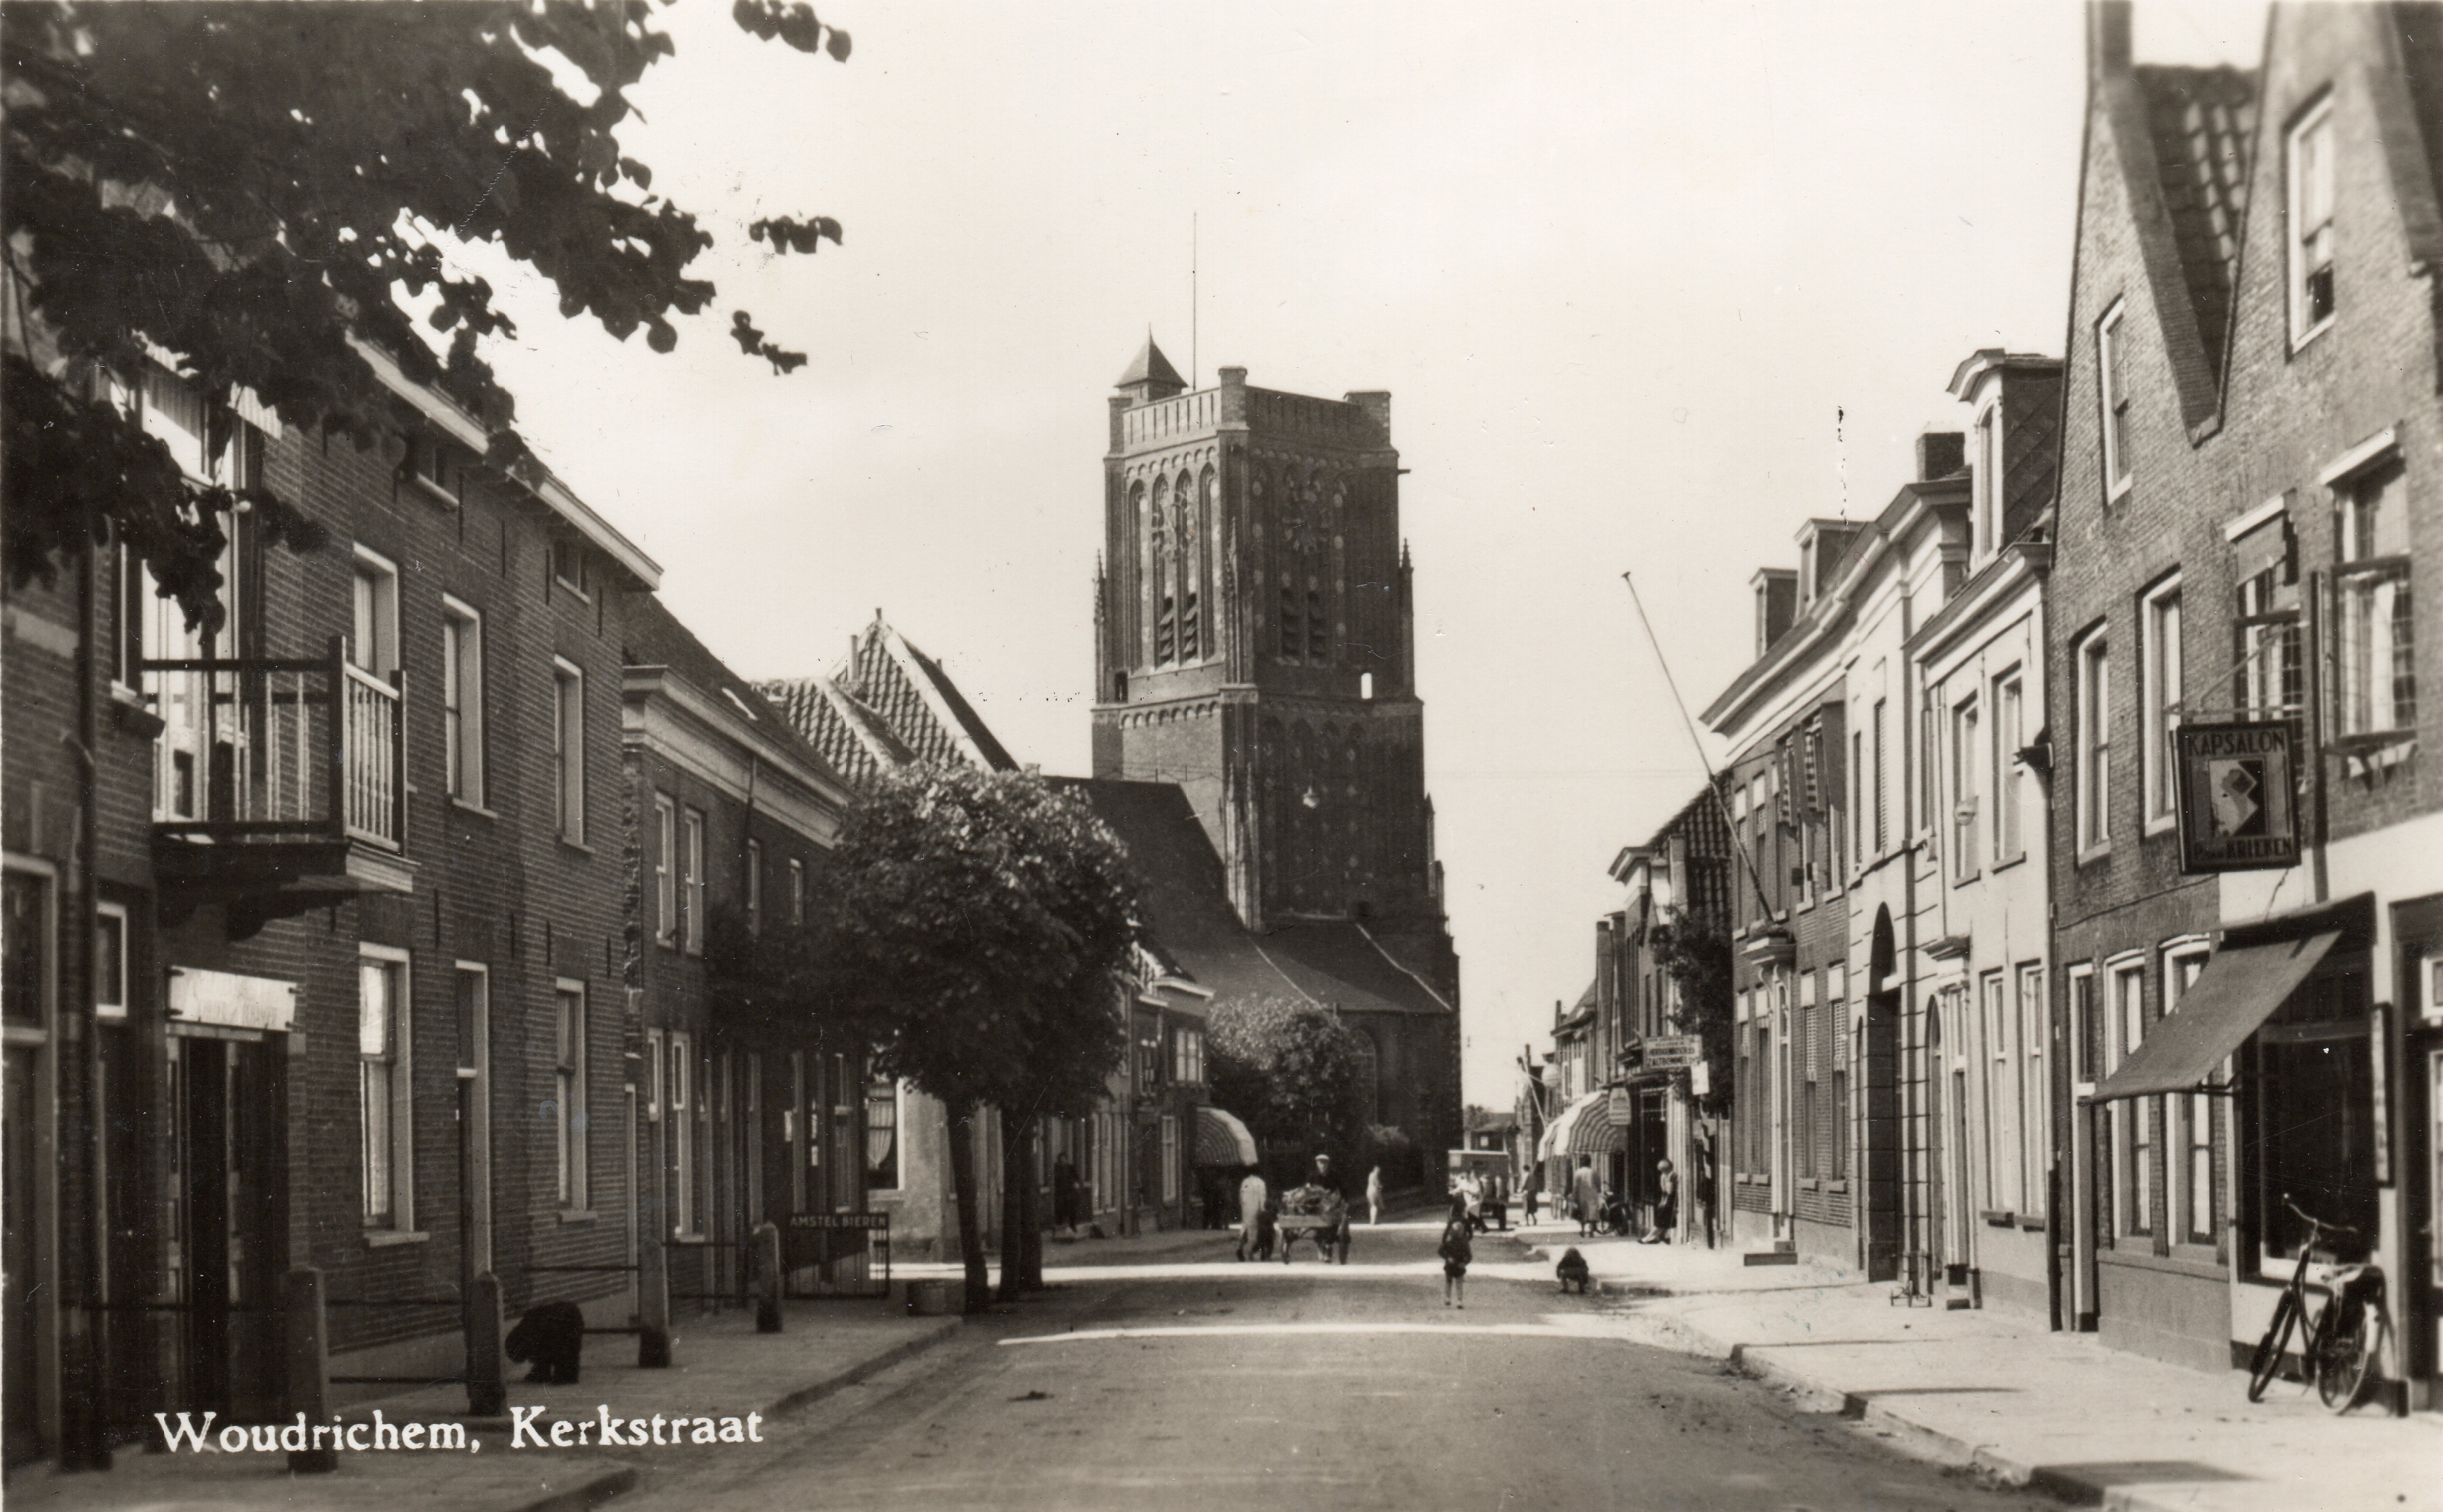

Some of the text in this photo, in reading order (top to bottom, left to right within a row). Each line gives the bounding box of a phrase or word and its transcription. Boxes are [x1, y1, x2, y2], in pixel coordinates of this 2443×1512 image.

[2187, 732, 2286, 756] KAPSALON
[2226, 838, 2292, 858] KRIEKEN
[790, 1215, 840, 1227] AMSTEL
